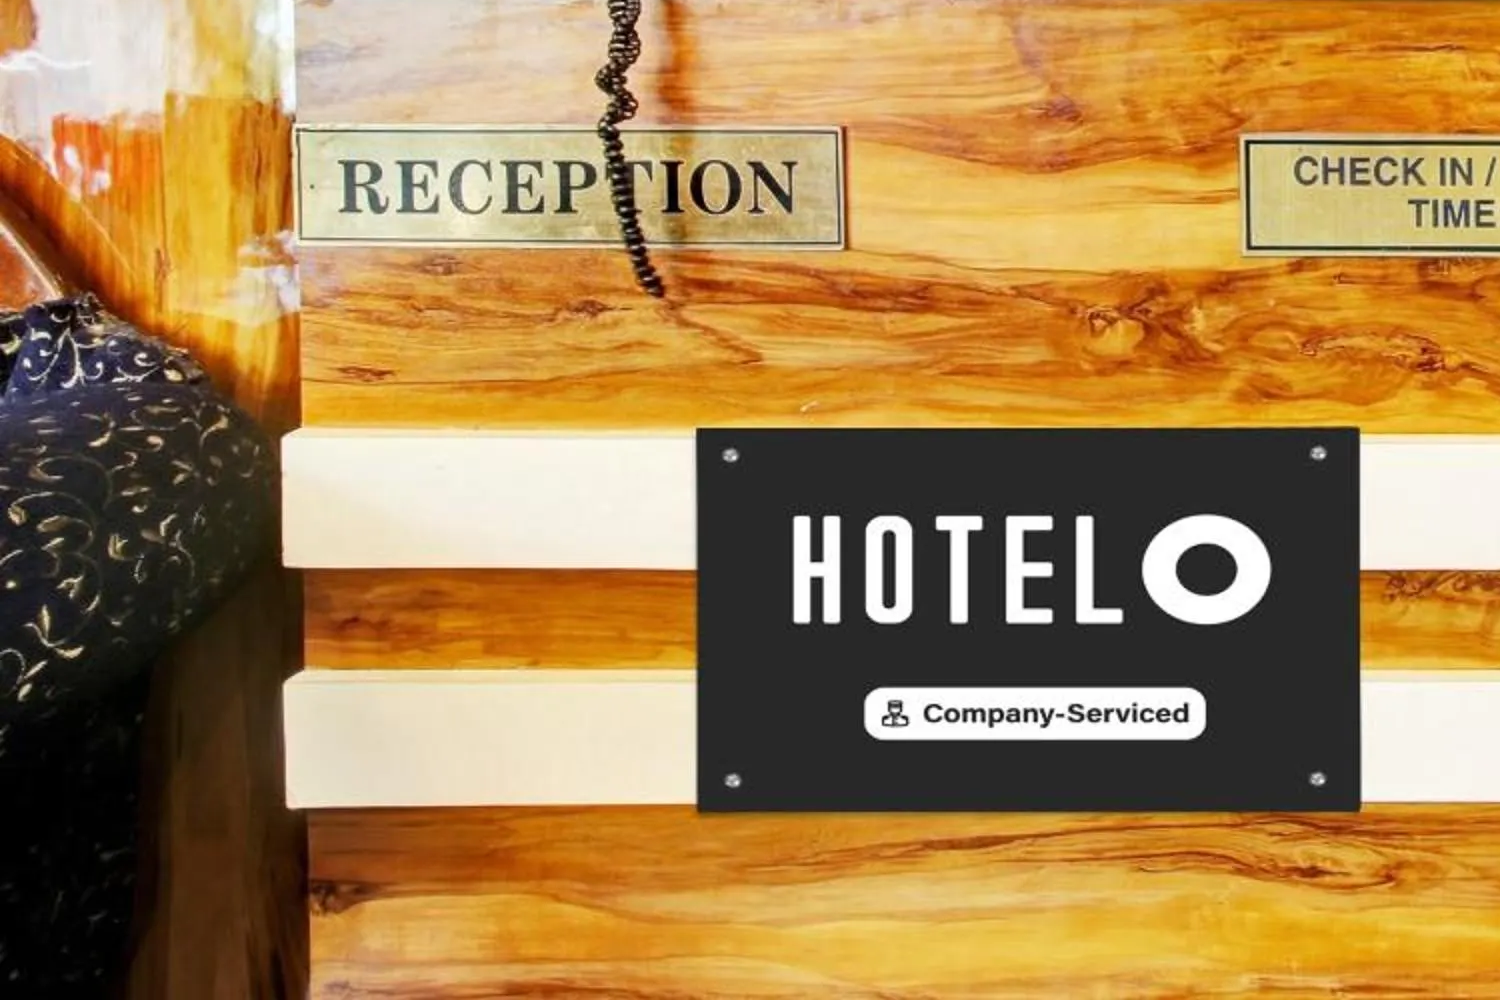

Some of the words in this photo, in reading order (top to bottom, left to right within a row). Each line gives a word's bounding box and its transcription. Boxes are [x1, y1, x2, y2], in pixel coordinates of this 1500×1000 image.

[1293, 156, 1426, 187] CHECK
[1438, 157, 1474, 187] IN
[922, 702, 1190, 731] Company-Serviced
